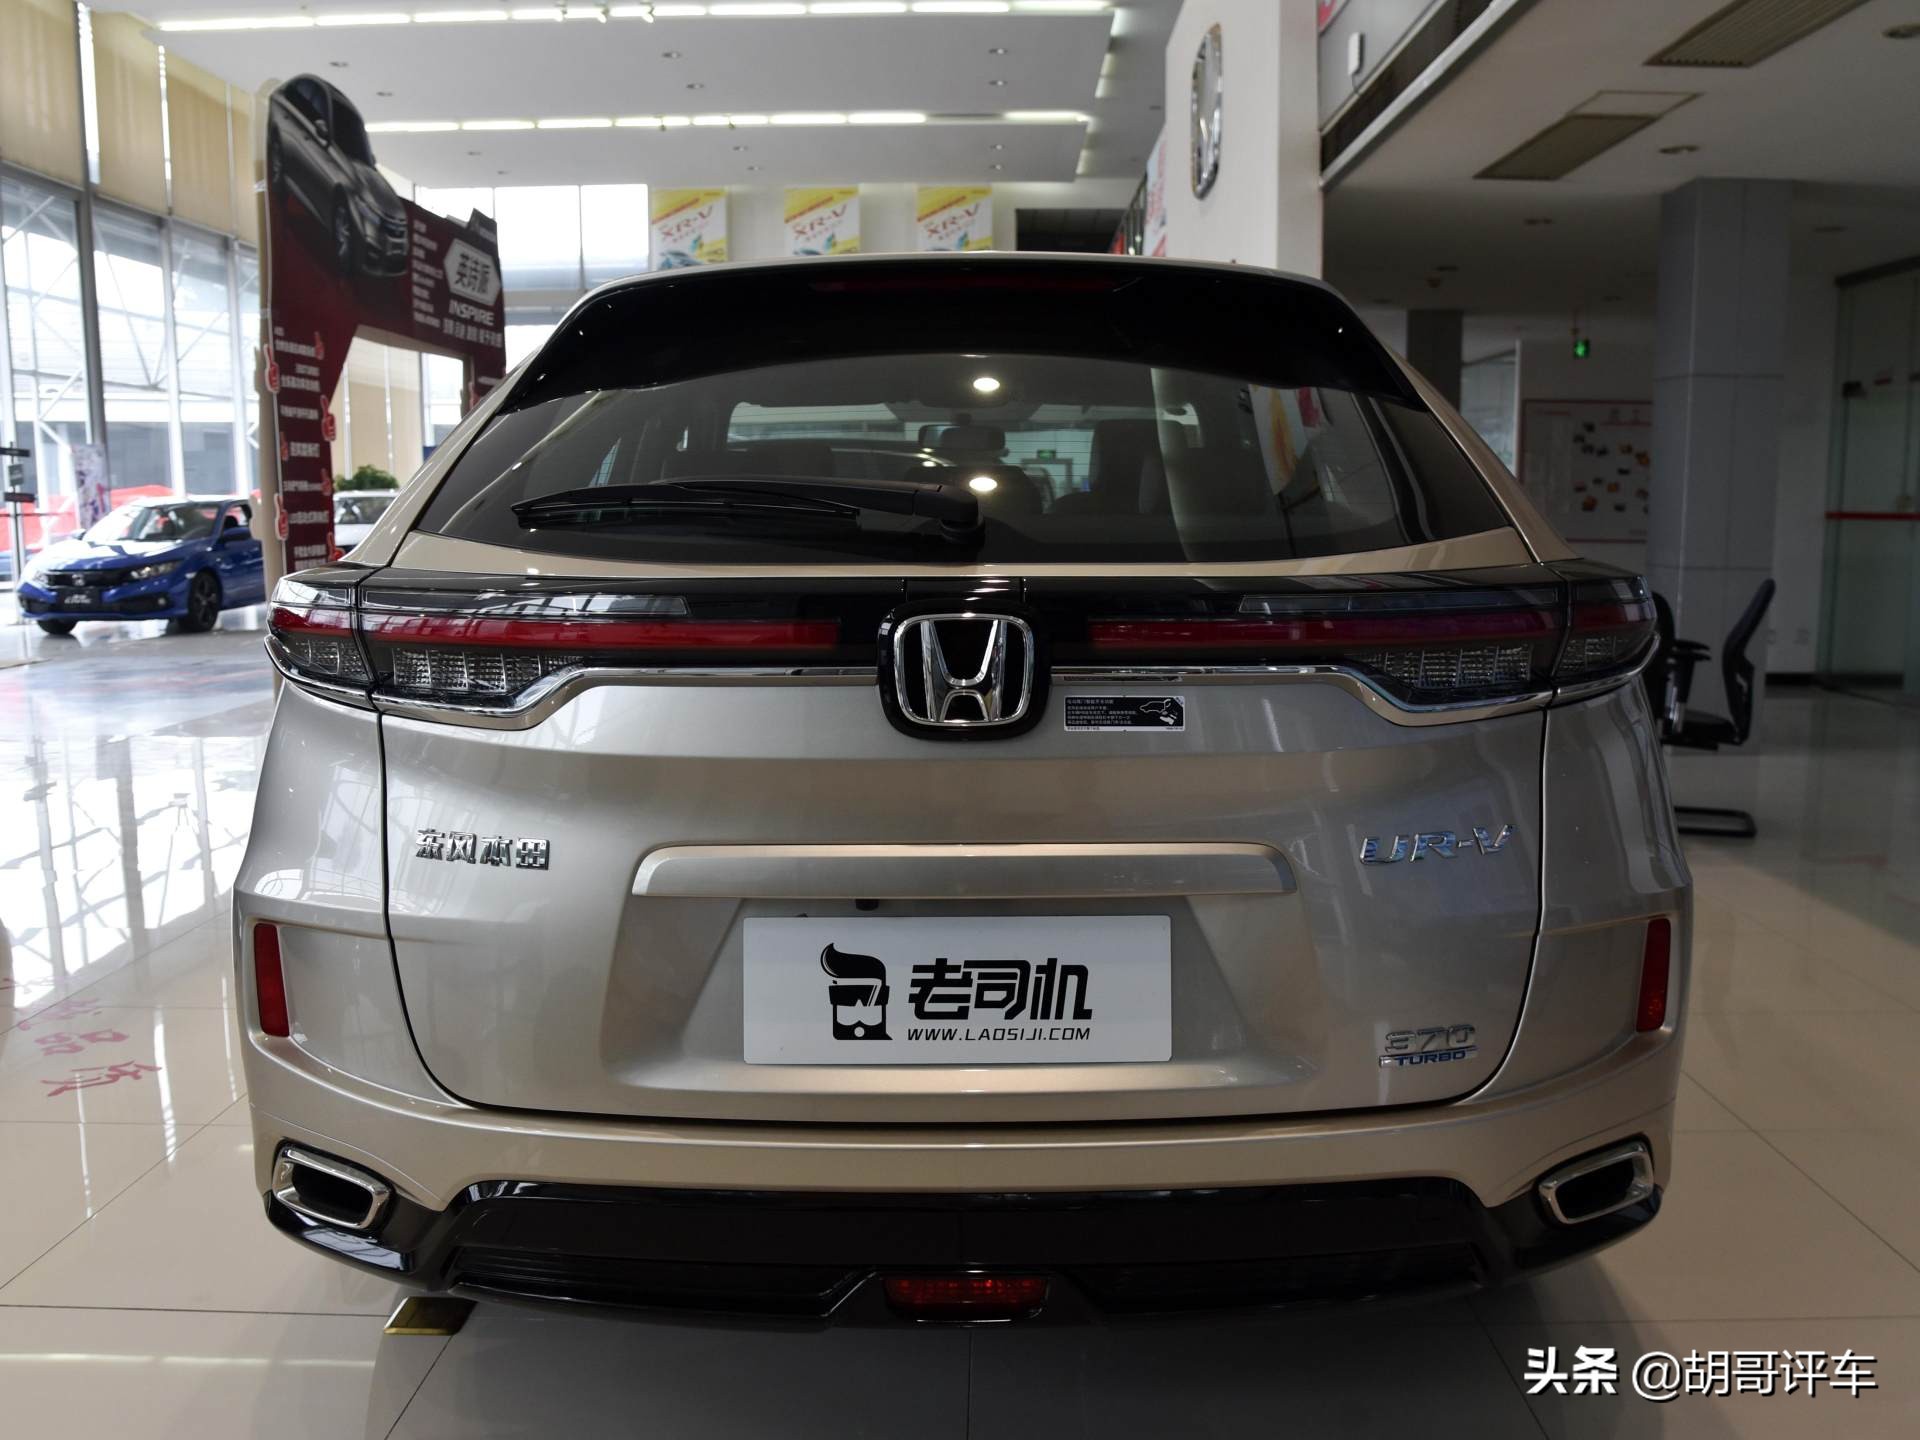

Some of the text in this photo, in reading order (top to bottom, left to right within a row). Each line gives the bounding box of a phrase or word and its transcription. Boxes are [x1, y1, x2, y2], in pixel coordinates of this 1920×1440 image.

[661, 205, 713, 239] XR-V
[793, 204, 847, 239] XR-V
[926, 203, 980, 239] XR-V
[449, 299, 494, 326] INSPIRE
[415, 828, 550, 870] 东风本田
[1360, 824, 1514, 864] UR-V
[908, 957, 1093, 1020] 老司机
[907, 1027, 1090, 1041] WWW.LAOSIJI.COM
[1385, 1024, 1476, 1053] 370
[1394, 1050, 1467, 1066] TURBO
